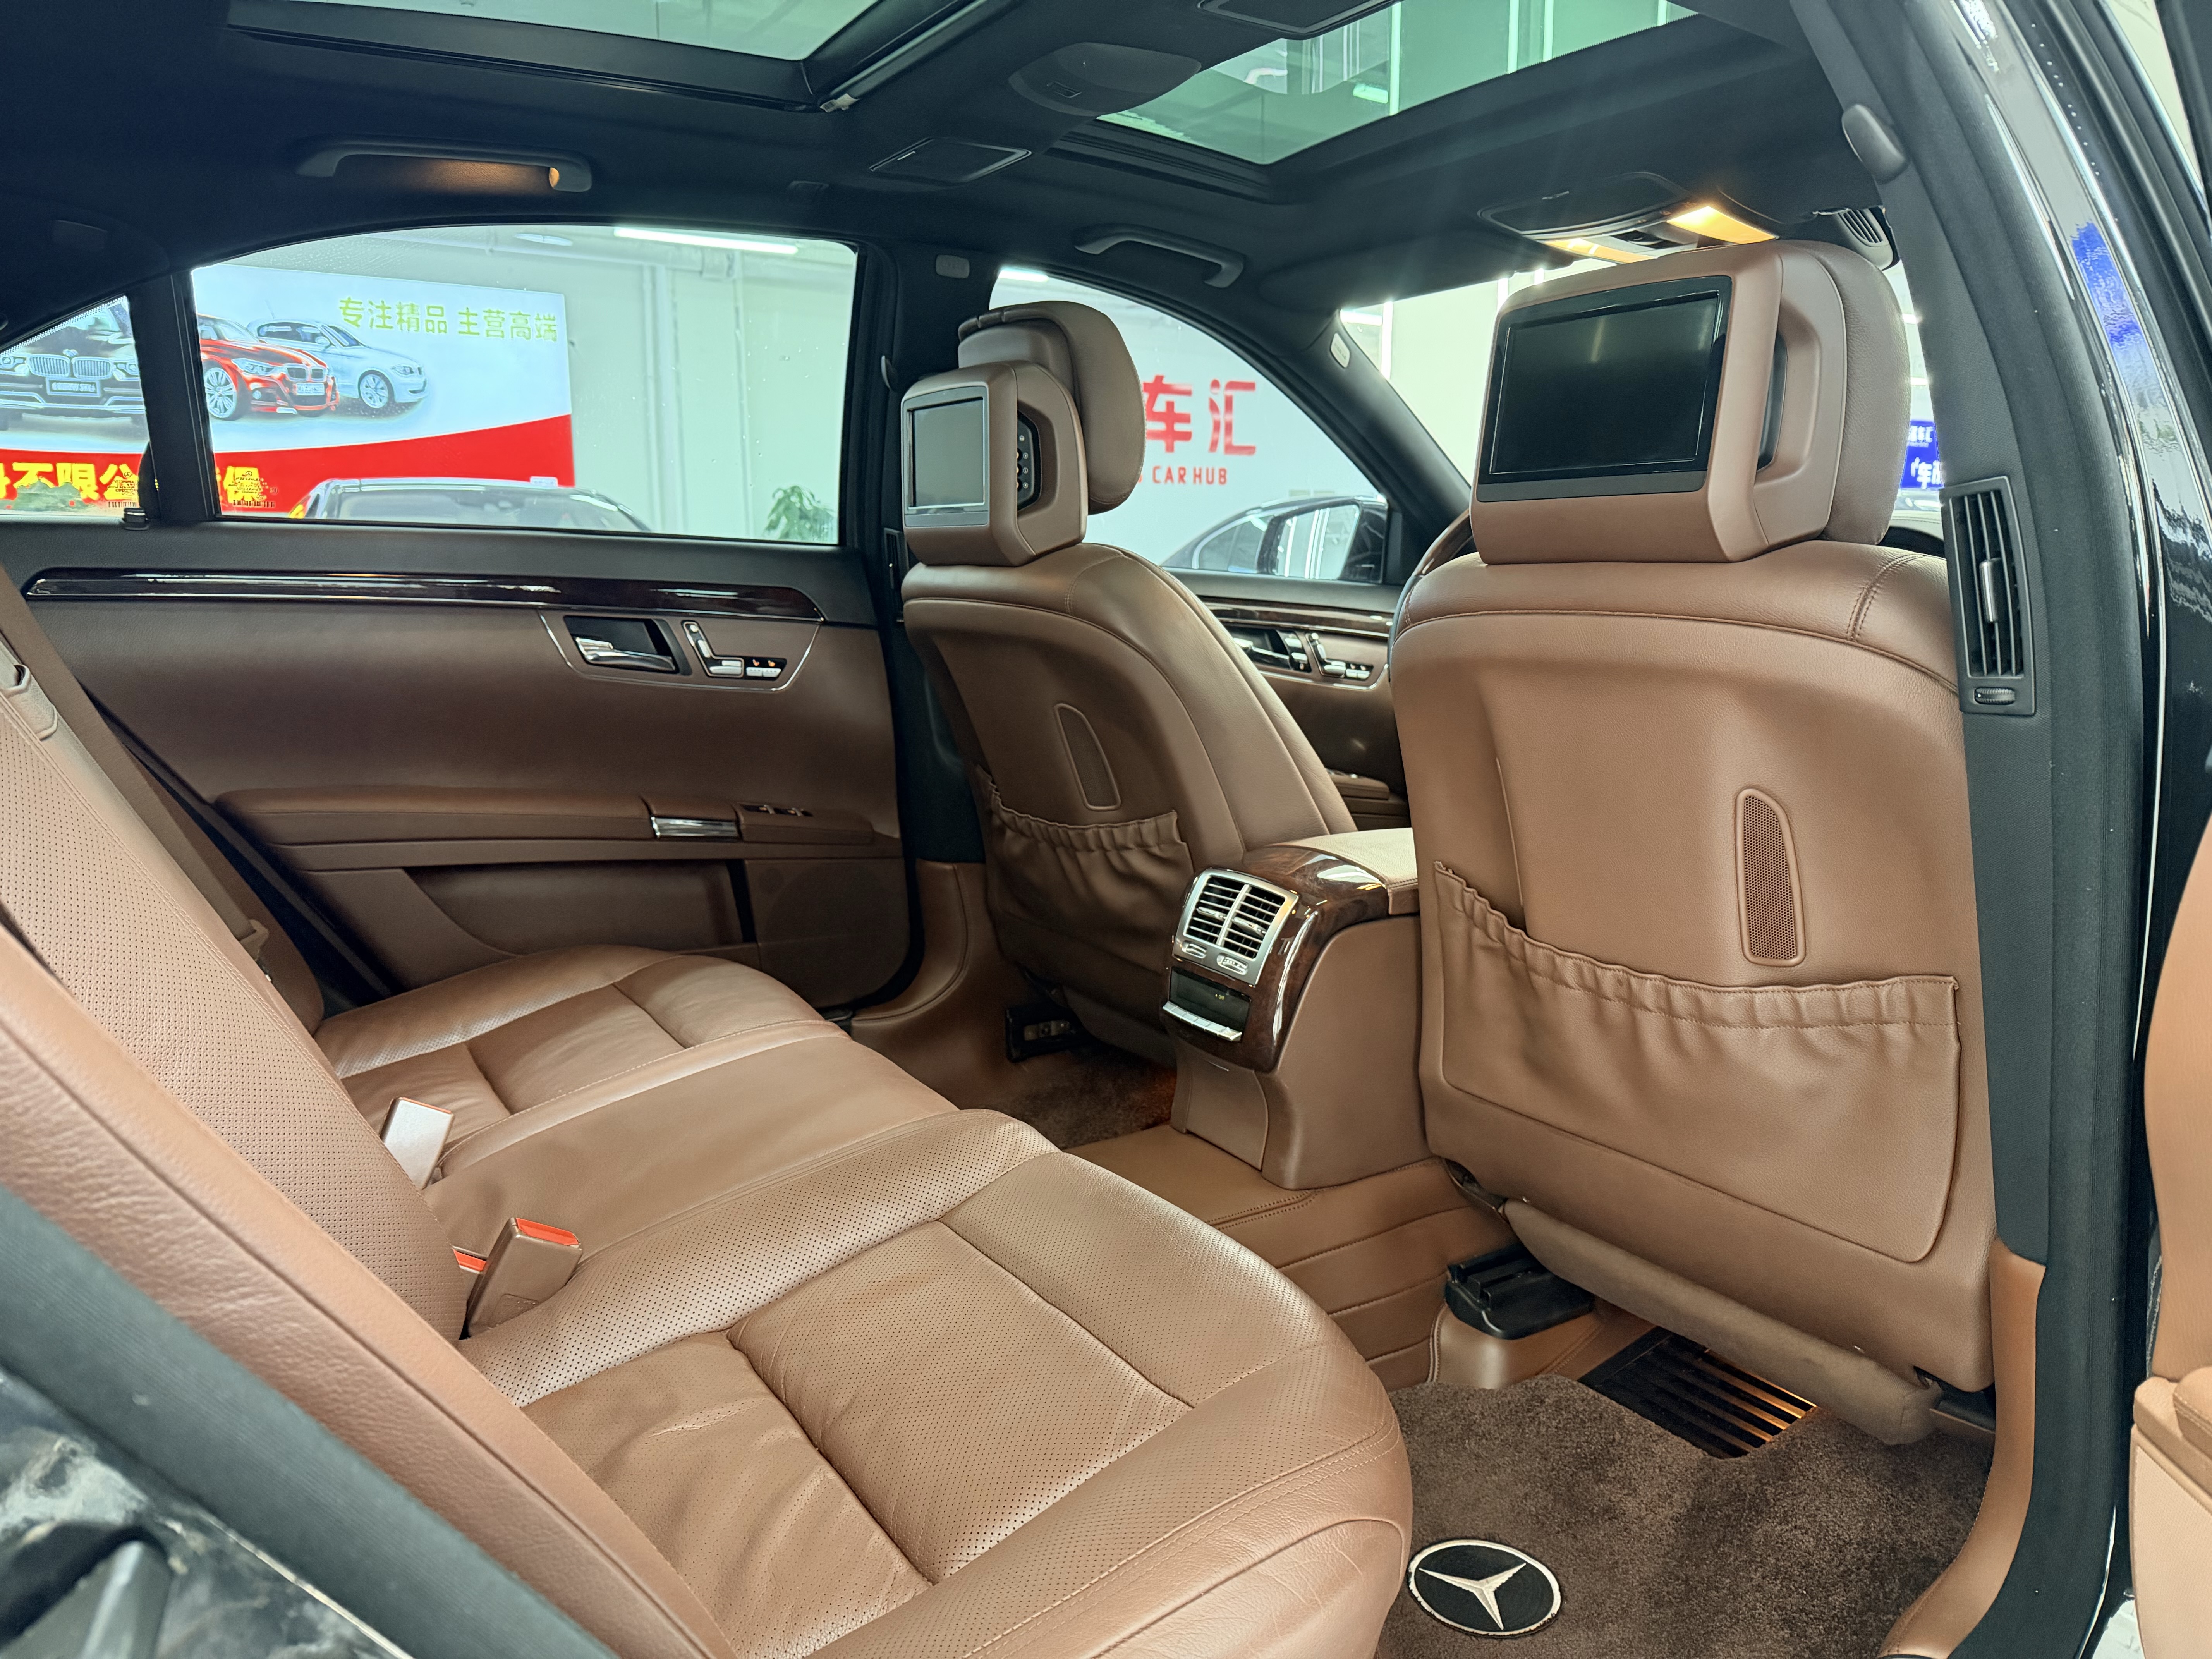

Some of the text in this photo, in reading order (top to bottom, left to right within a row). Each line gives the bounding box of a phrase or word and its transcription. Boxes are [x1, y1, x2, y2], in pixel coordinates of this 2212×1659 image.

[339, 297, 557, 342] 专注精品 主营高端
[0, 462, 138, 500] 不限公
[1152, 465, 1186, 484] CAR
[1193, 466, 1227, 485] HUB
